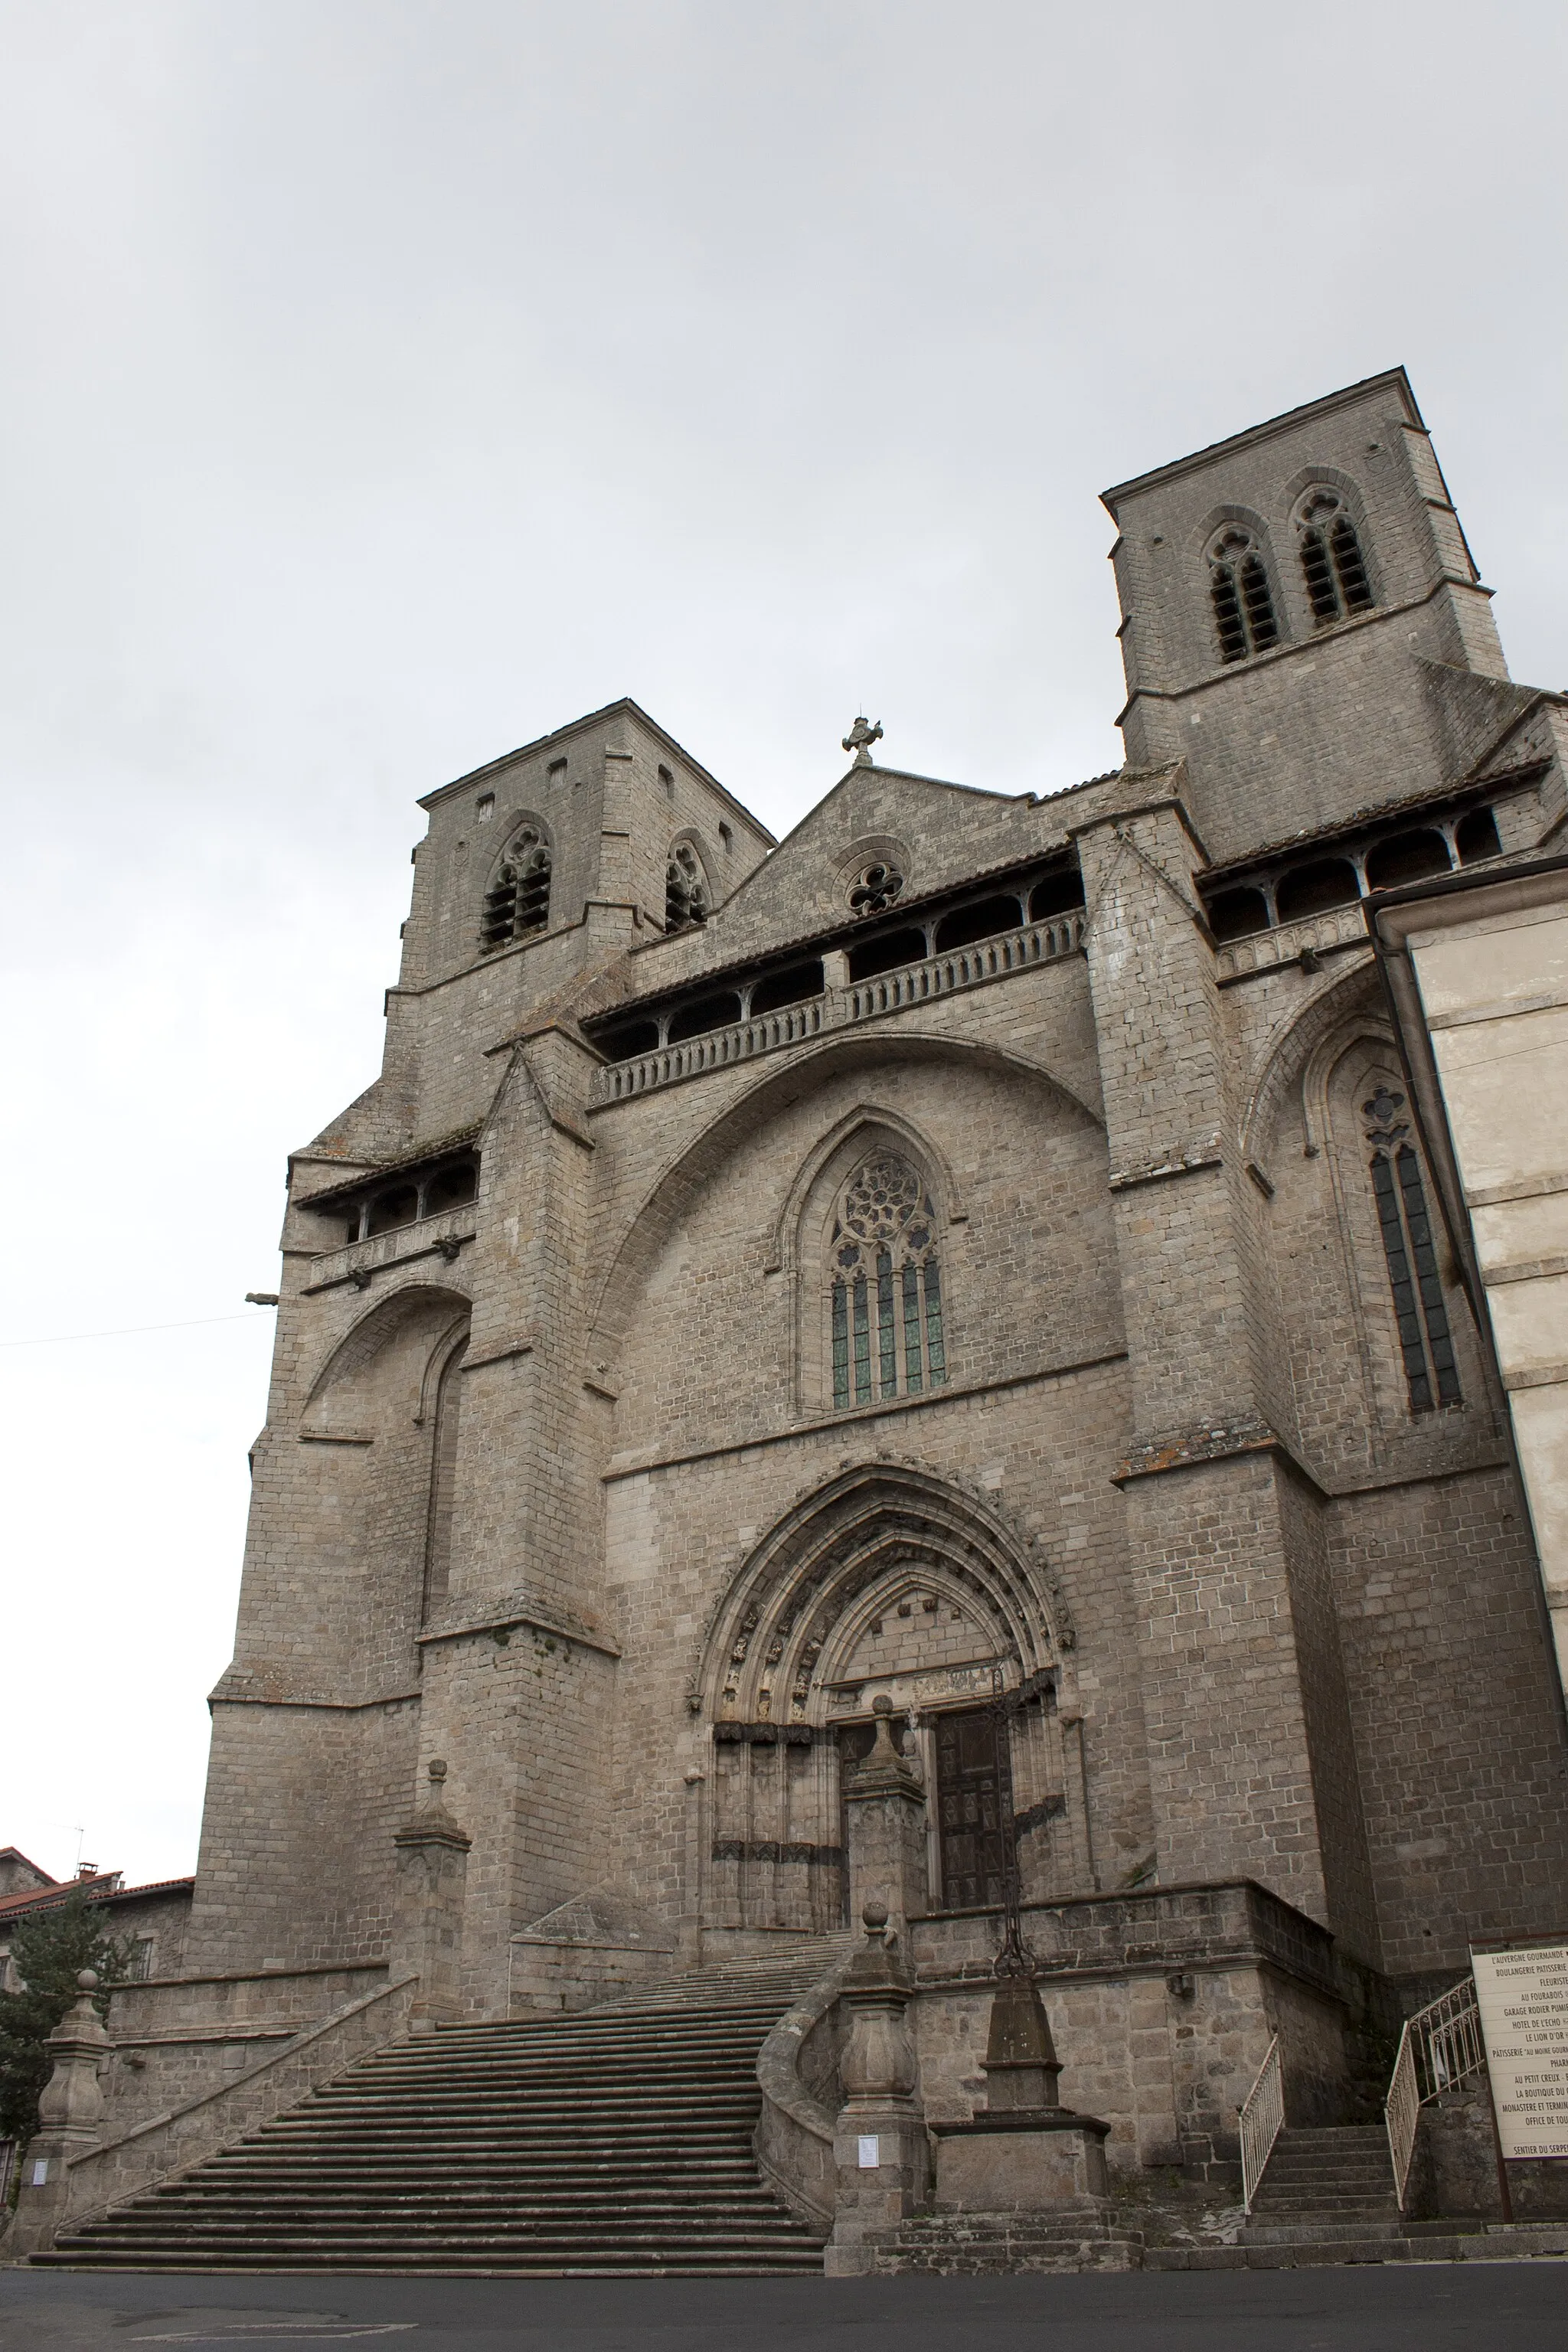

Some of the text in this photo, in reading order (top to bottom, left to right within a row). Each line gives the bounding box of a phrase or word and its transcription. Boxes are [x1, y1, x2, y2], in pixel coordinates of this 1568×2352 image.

[1491, 1951, 1563, 1965] L'AUVERGNE GOURMANDE
[1495, 1964, 1566, 1977] BOULANGERIE PATISSERIE
[1540, 1977, 1568, 1987] FLEURISTE
[1530, 1991, 1563, 2001] FOURABOIS
[1504, 2007, 1527, 2016] GARAGE
[1529, 2005, 1550, 2014] RODIER
[1512, 2020, 1530, 2029] HOTEL
[1541, 2018, 1560, 2027] L'ECHO
[1526, 2034, 1532, 2042] LE
[1534, 2033, 1548, 2041] LION
[1524, 2075, 1539, 2083] PETIT
[1541, 2074, 1560, 2082] CREUX
[1525, 2089, 1554, 2097] BOUTIQUE
[1556, 2087, 1564, 2096] DU
[1502, 2103, 1537, 2112] MONASTERE
[1538, 2102, 1544, 2111] ET
[1525, 2117, 1545, 2125] OFFICE
[1514, 2146, 1537, 2154] SENTIER
[1539, 2145, 1548, 2154] DU
